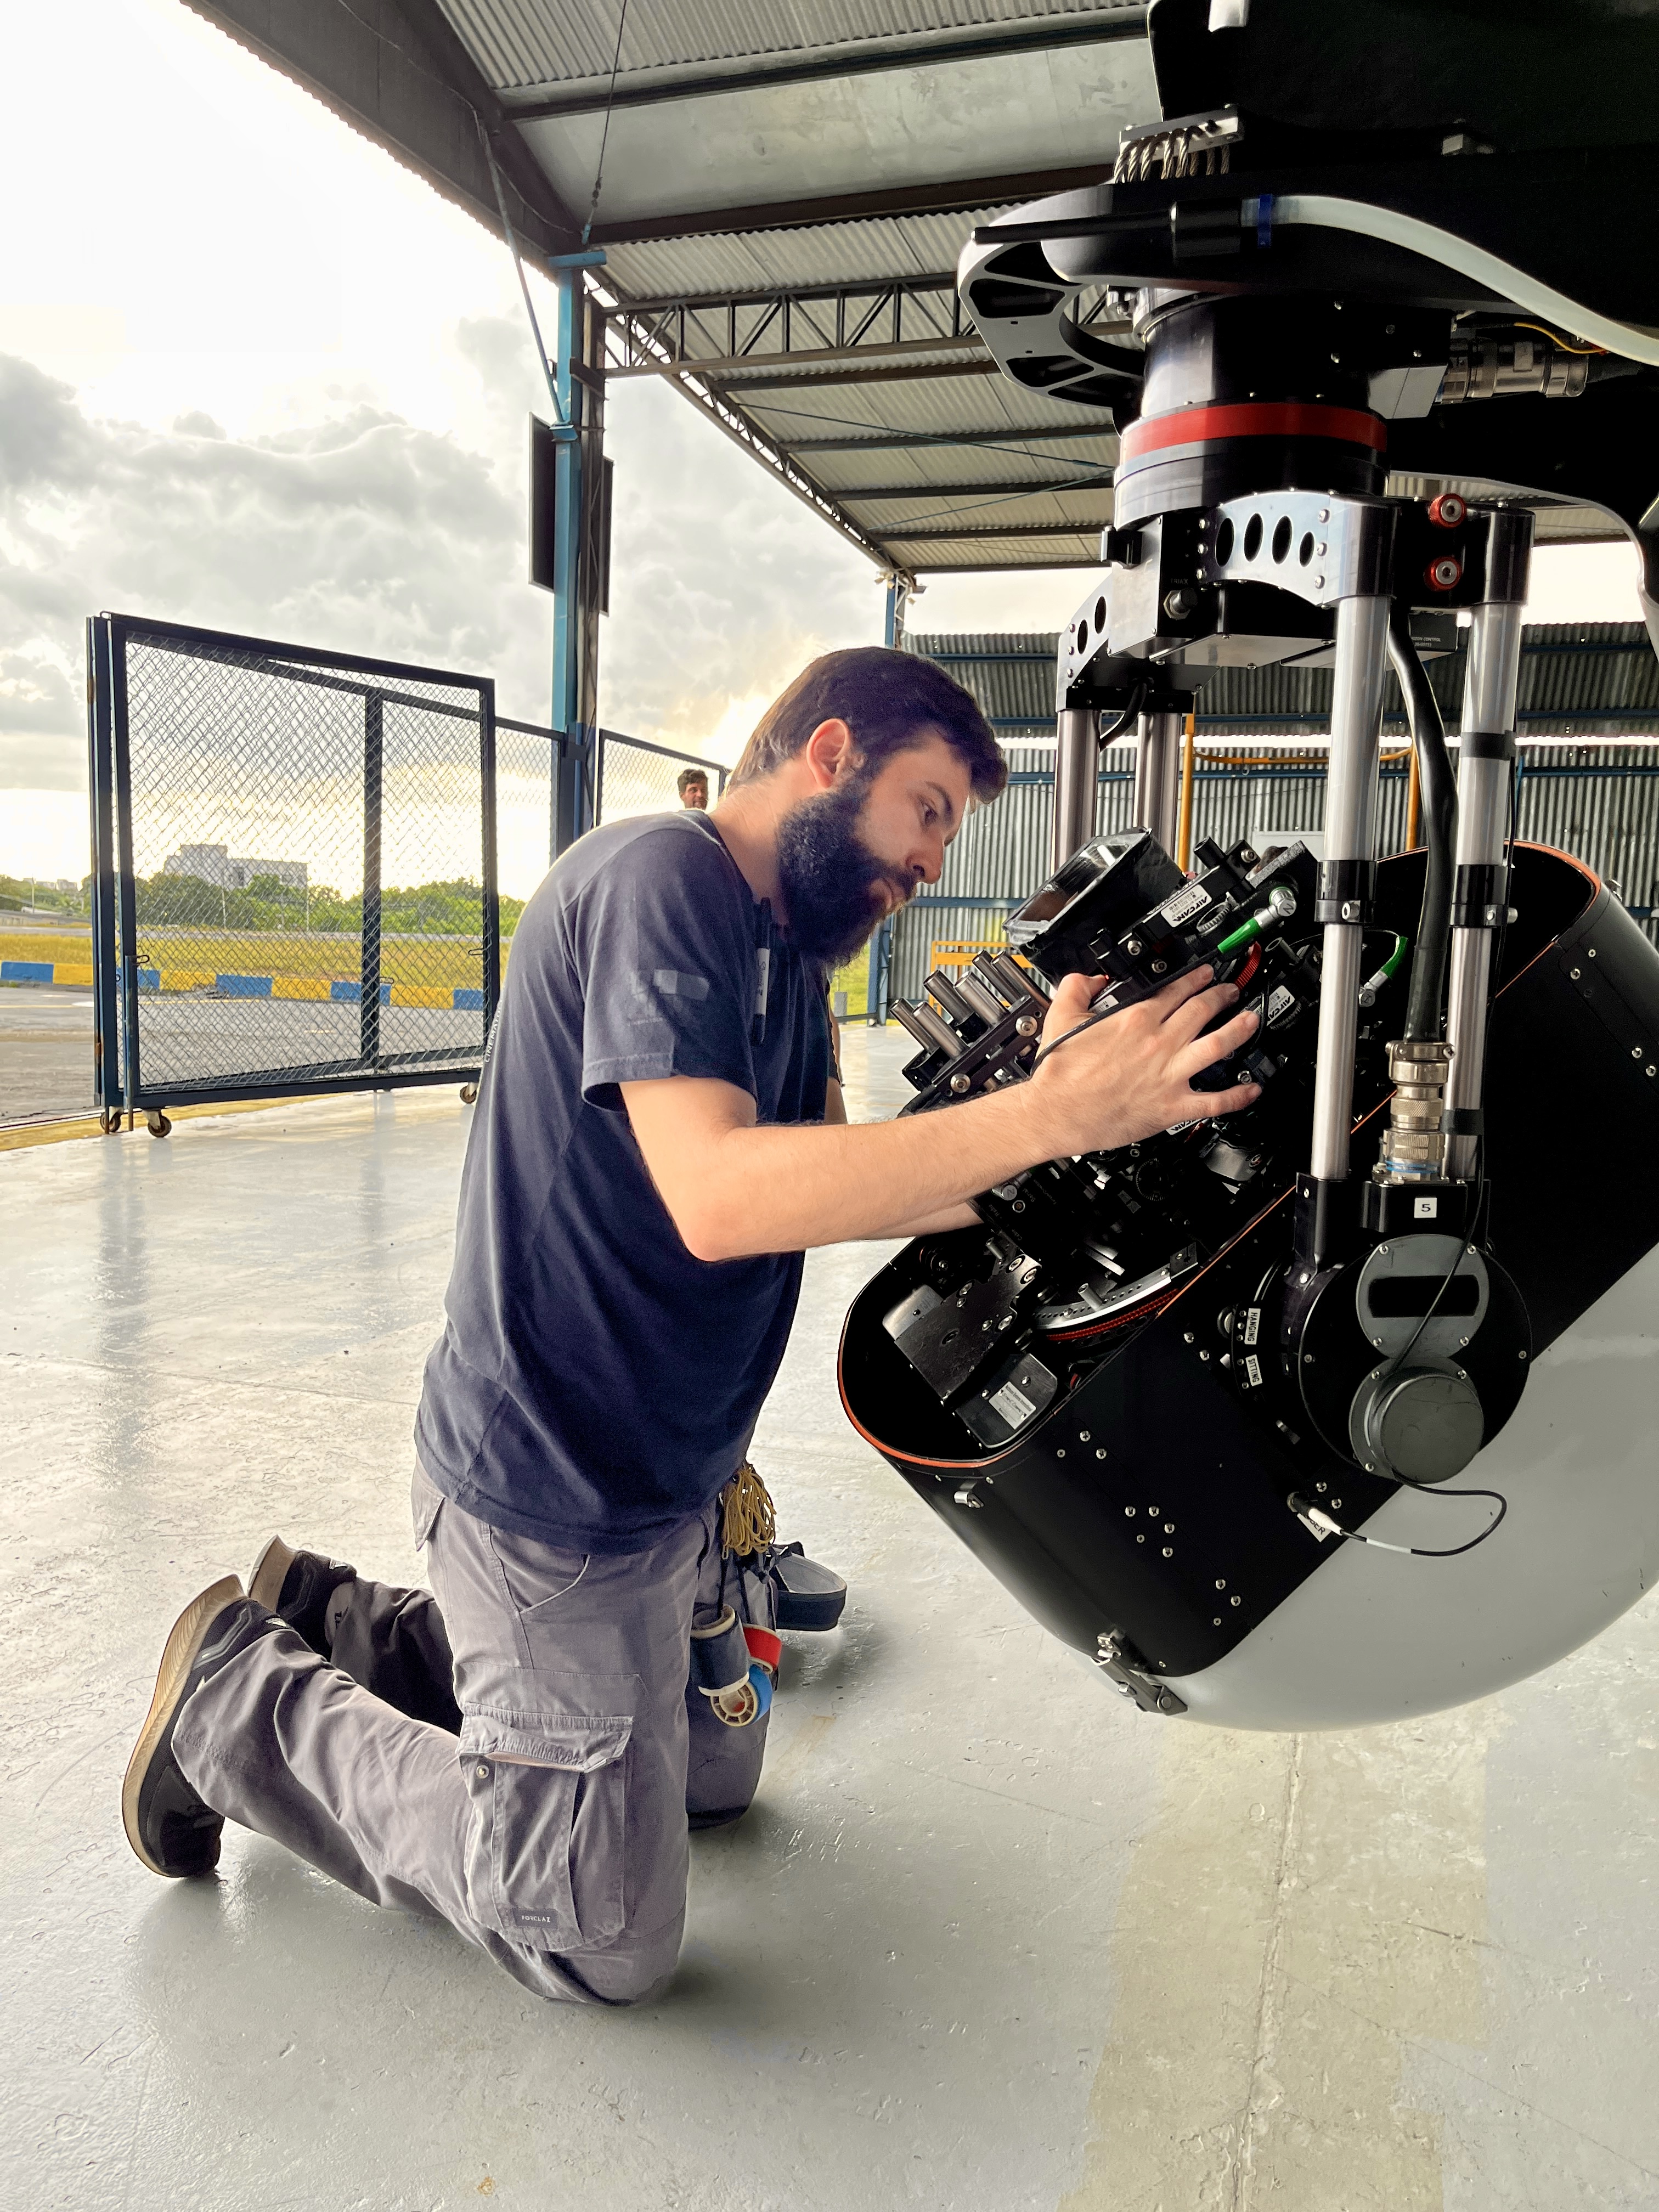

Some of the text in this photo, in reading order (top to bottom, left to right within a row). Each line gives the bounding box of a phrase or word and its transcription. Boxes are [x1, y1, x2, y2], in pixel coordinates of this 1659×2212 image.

[1021, 1187, 1036, 1203] Serial
[1421, 1204, 1431, 1212] 5
[1247, 1312, 1258, 1342] HANGING
[1248, 1358, 1260, 1383] SITTING
[521, 1915, 551, 1923] FORCLAZ
